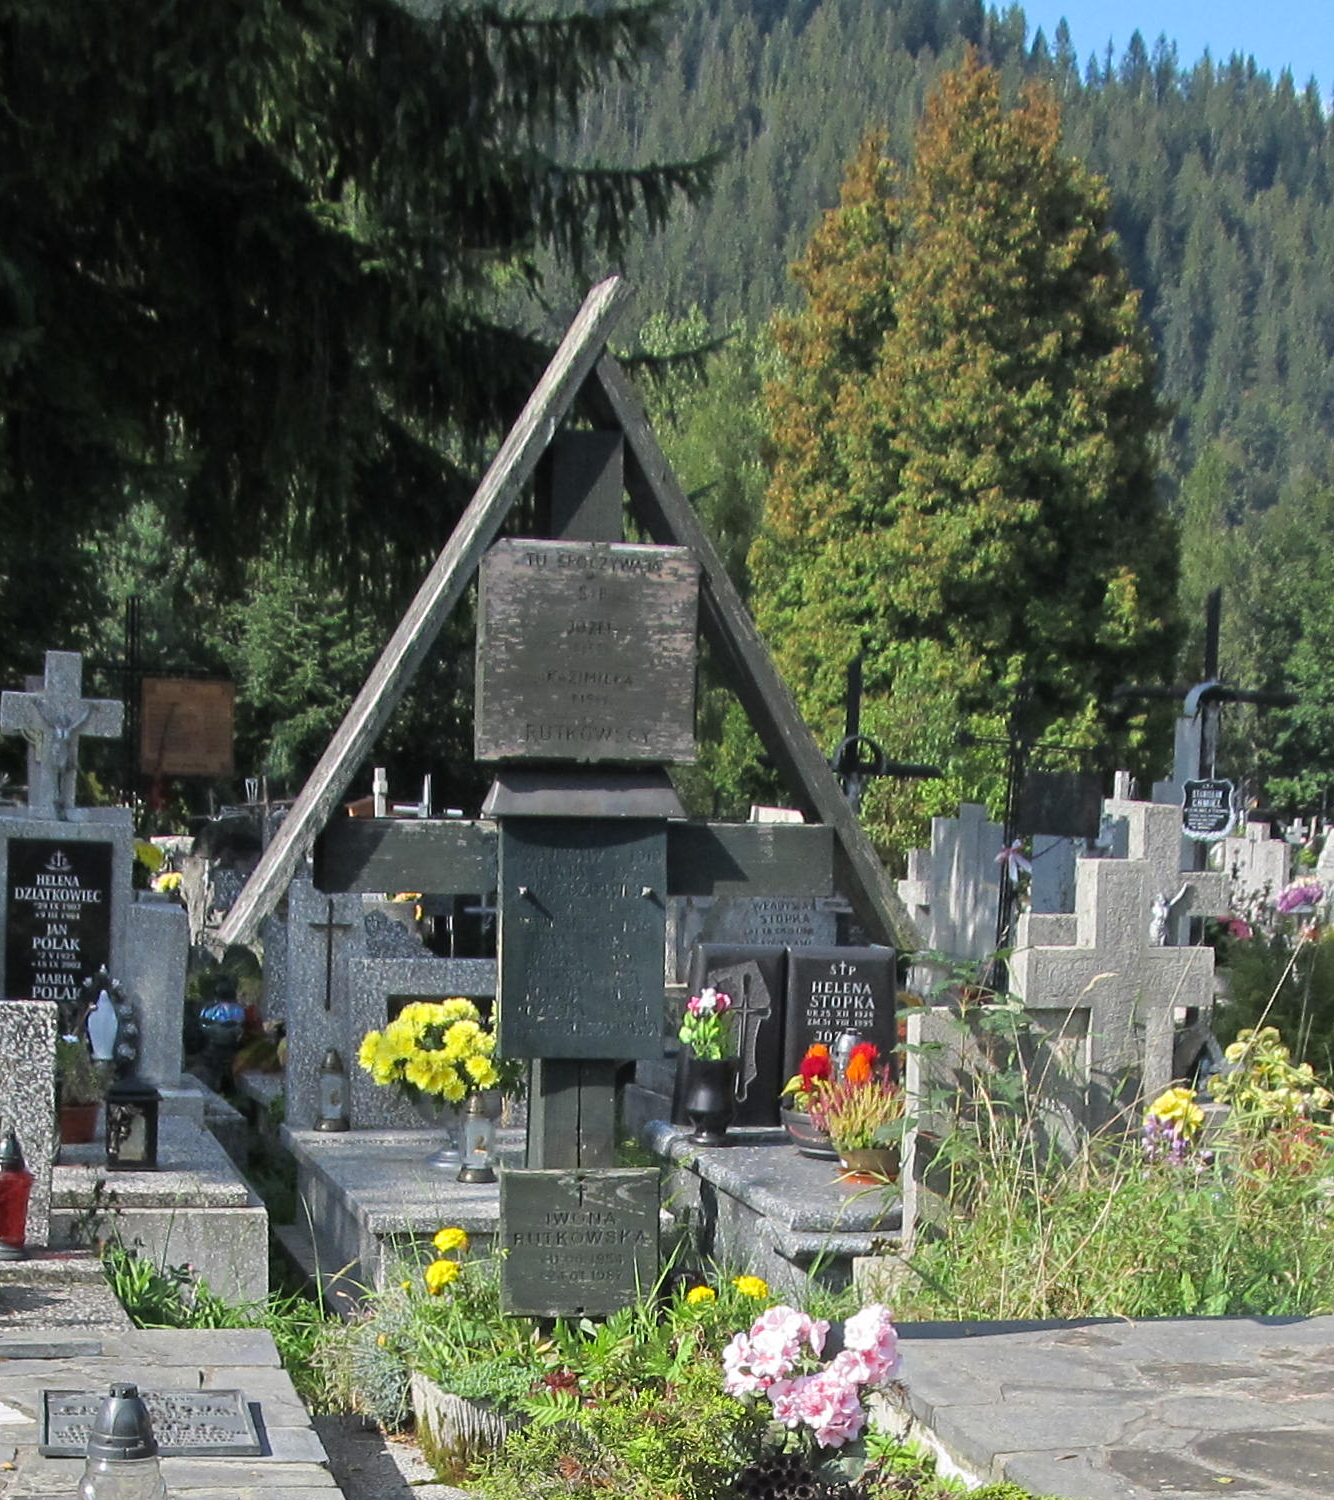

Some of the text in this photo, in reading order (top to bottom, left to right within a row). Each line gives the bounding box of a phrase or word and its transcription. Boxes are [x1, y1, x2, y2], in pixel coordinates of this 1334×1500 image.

[36, 874, 80, 887] HELENA
[14, 887, 102, 903] DZIATKOWIEC
[47, 923, 67, 936] JAN
[32, 937, 80, 951] POLAK
[35, 973, 75, 985] MARIA
[811, 981, 872, 994] HELENA
[809, 994, 875, 1010] STOPKA
[545, 1212, 616, 1226] IWONA
[515, 1229, 647, 1247] RUTKOWSKA
